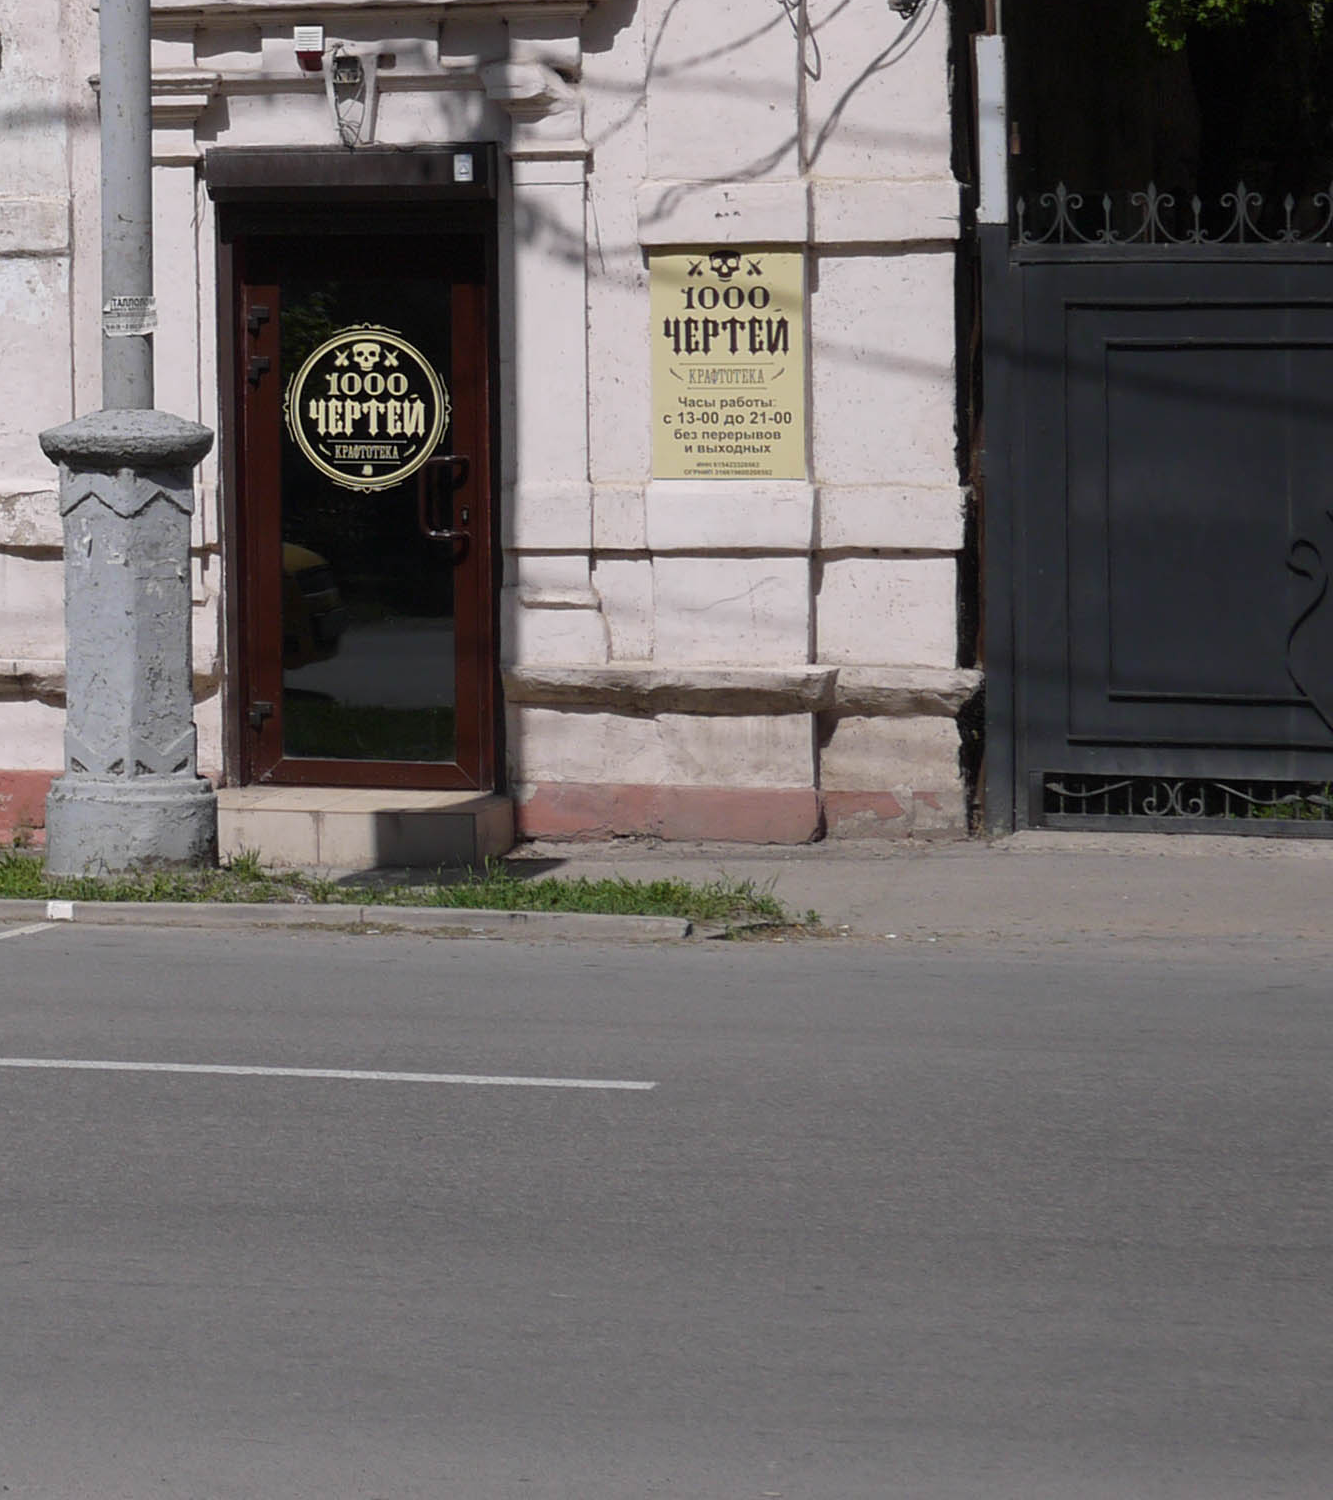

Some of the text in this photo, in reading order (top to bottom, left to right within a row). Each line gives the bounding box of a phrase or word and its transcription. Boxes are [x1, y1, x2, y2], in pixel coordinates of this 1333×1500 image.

[681, 286, 770, 309] 1000
[663, 308, 789, 356] ЧЕРТЕЙ
[689, 368, 764, 384] КРАФТОТЕКА
[325, 372, 408, 396] 1000
[678, 396, 777, 410] Часы работы:
[309, 394, 425, 437] ЧЕРТЕЙ
[663, 411, 792, 426] с 13-00 до 21-00
[674, 429, 781, 442] без перерывов
[335, 445, 399, 459] КРАФТОТЕКА
[685, 445, 771, 455] и выходных
